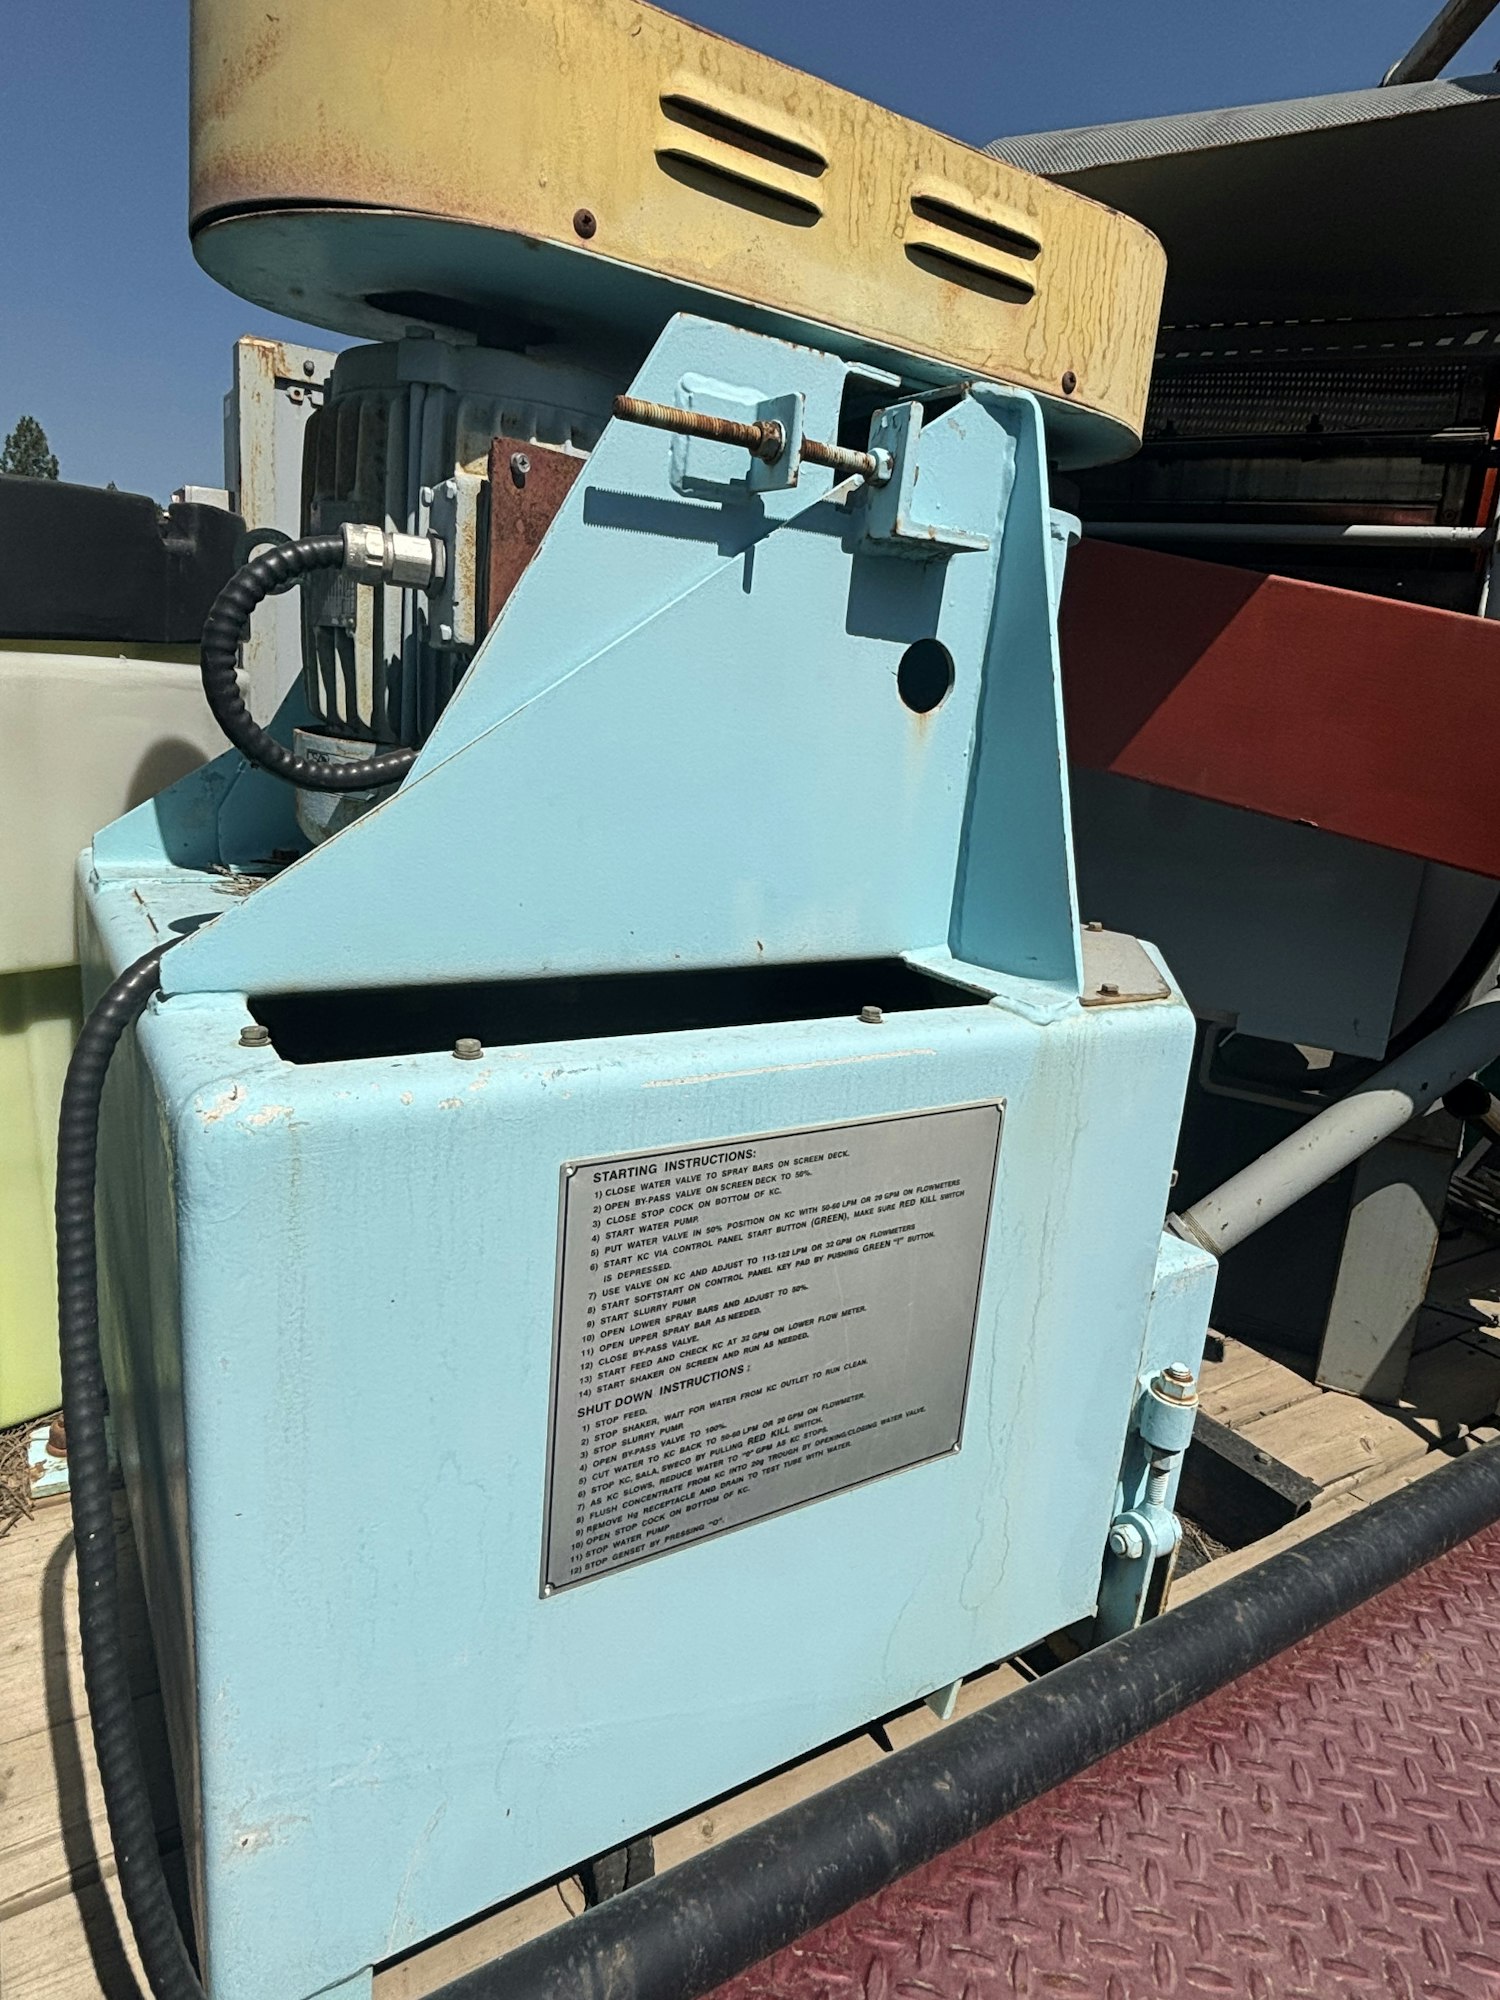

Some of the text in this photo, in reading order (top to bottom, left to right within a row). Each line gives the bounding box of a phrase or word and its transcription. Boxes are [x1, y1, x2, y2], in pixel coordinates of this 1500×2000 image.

[593, 1149, 756, 1183] STARTING INSTRUCTIONS:
[594, 1190, 603, 1200] 1)
[605, 1184, 636, 1197] CLOSE
[640, 1179, 671, 1191] WATER
[675, 1174, 702, 1185] VALVE
[706, 1171, 718, 1180] TO
[721, 1166, 749, 1178] SPRAY
[793, 1154, 824, 1166] SCREEN
[592, 1192, 750, 1229] 3) CLOSE STOP COCK ON BOTTOM
[593, 1179, 753, 1214] 2) OPEN BY-PASS VALVE ON SCREEN
[589, 1263, 599, 1272] 6)
[603, 1255, 633, 1269] START
[637, 1252, 650, 1262] KC
[654, 1248, 669, 1258] VIA
[672, 1240, 714, 1254] CONTROL
[717, 1234, 743, 1246] PANEL
[590, 1216, 765, 1258] 5) PUT WATER VALVE IN 50% POSITION
[591, 1234, 600, 1243] 4)
[605, 1227, 635, 1240] START
[638, 1221, 669, 1234] WATER
[587, 1240, 891, 1315] 8) START SOFTSTART ON CONTROL PUSHING GREEN
[588, 1259, 744, 1301] 7) USE VALVE ON KC AND ADJUST
[603, 1274, 612, 1283] IS
[581, 1315, 726, 1357] 11) OPEN UPPER SPRAY BAR AS
[582, 1299, 741, 1343] 10) OPEN LOWER SPRAY BARS AND
[586, 1302, 668, 1329] 9) START SLURRY
[579, 1318, 815, 1385] 13) START FEED AND CHECK KC AT LOWER
[580, 1342, 668, 1371] 12) CLOSE BY-PASS
[579, 1350, 740, 1398] 14) START SHAKER ON SCREEN AND
[577, 1400, 612, 1418] SHUT
[614, 1389, 653, 1408] DOWN
[581, 1438, 589, 1446] 2)
[594, 1429, 618, 1442] STOP
[622, 1418, 660, 1434] SHAKER,
[664, 1410, 685, 1422] WAIT
[780, 1374, 809, 1389] OUTLET
[582, 1416, 619, 1432] 1) STOP
[577, 1426, 790, 1498] 6) STOP KC, SALA, SWECO RED KILL
[578, 1441, 702, 1485] 5) CUT WATER TO KC BACK
[579, 1434, 686, 1472] 4) OPEN BY-PASS VALVE
[580, 1430, 656, 1459] 3) STOP SLURRY
[576, 1447, 799, 1524] 8) FLUSH CONCENTRATE TROUGH
[577, 1468, 693, 1512] 7) AS KC SLOWS, REDUCE
[571, 1495, 719, 1551] 10) OPEN STOP COCK ON BOTTOM
[575, 1491, 696, 1537] 9) REMOVE RECEPTACLE
[570, 1524, 670, 1563] 11) STOP WATER PUMP
[570, 1524, 705, 1575] 12) STOP GENSET BY PRESSING
